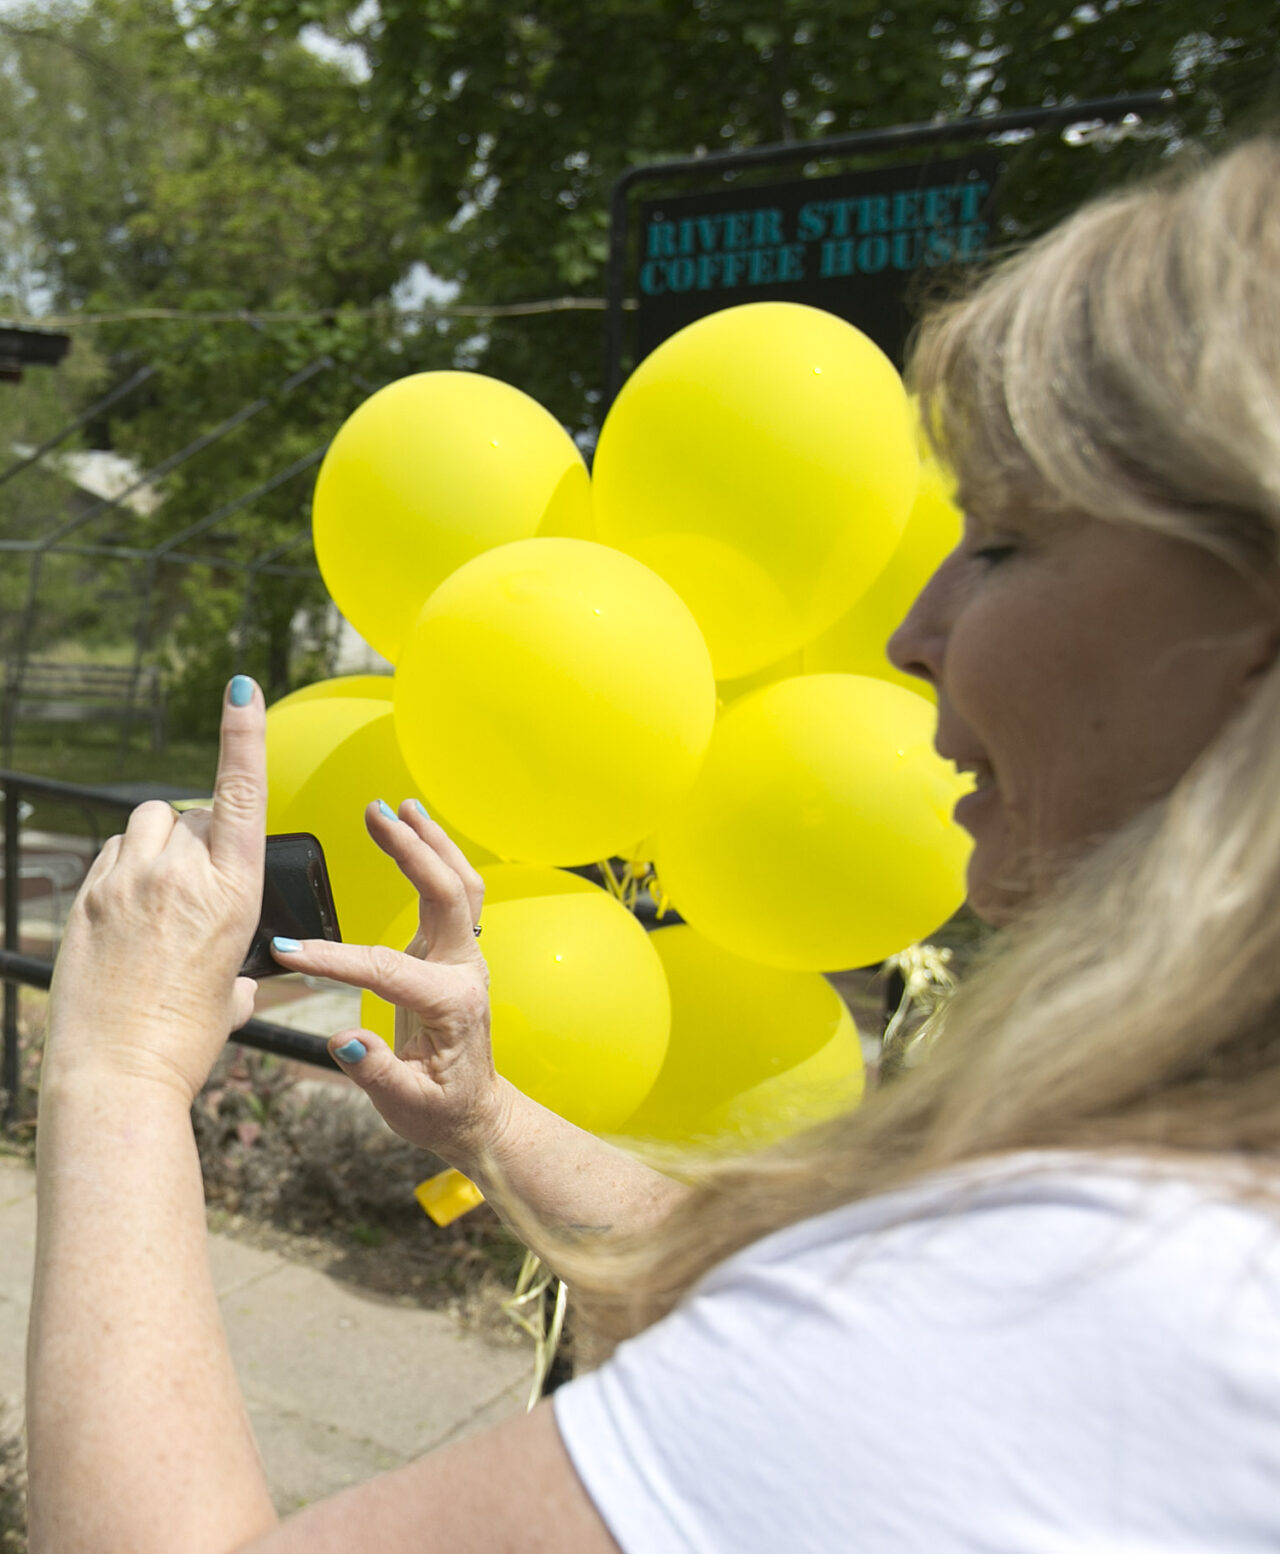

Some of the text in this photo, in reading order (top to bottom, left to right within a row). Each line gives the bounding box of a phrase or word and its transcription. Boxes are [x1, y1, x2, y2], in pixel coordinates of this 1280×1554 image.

[646, 182, 990, 258] RIVER STREET
[640, 224, 989, 295] COFFEE HOUSE
